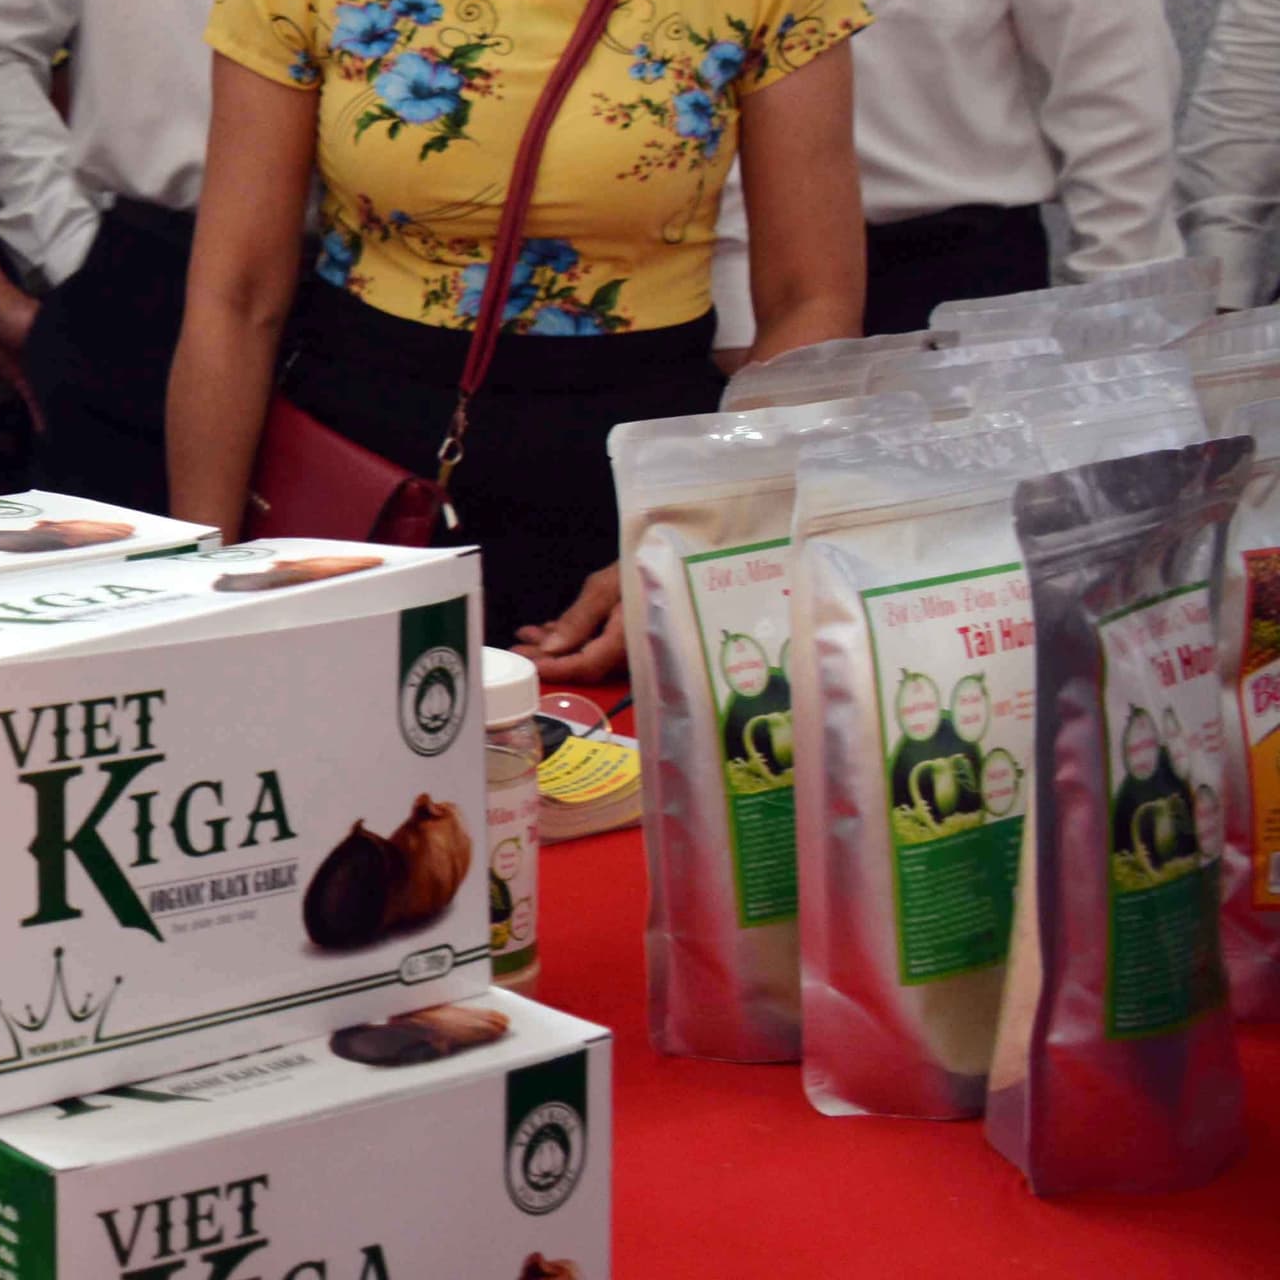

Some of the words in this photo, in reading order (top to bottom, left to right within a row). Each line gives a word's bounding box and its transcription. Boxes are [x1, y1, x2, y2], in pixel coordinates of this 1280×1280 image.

[17, 753, 299, 944] KIGA
[208, 872, 250, 903] BLACK
[253, 863, 300, 894] GARLIC
[95, 1173, 270, 1269] VIET
